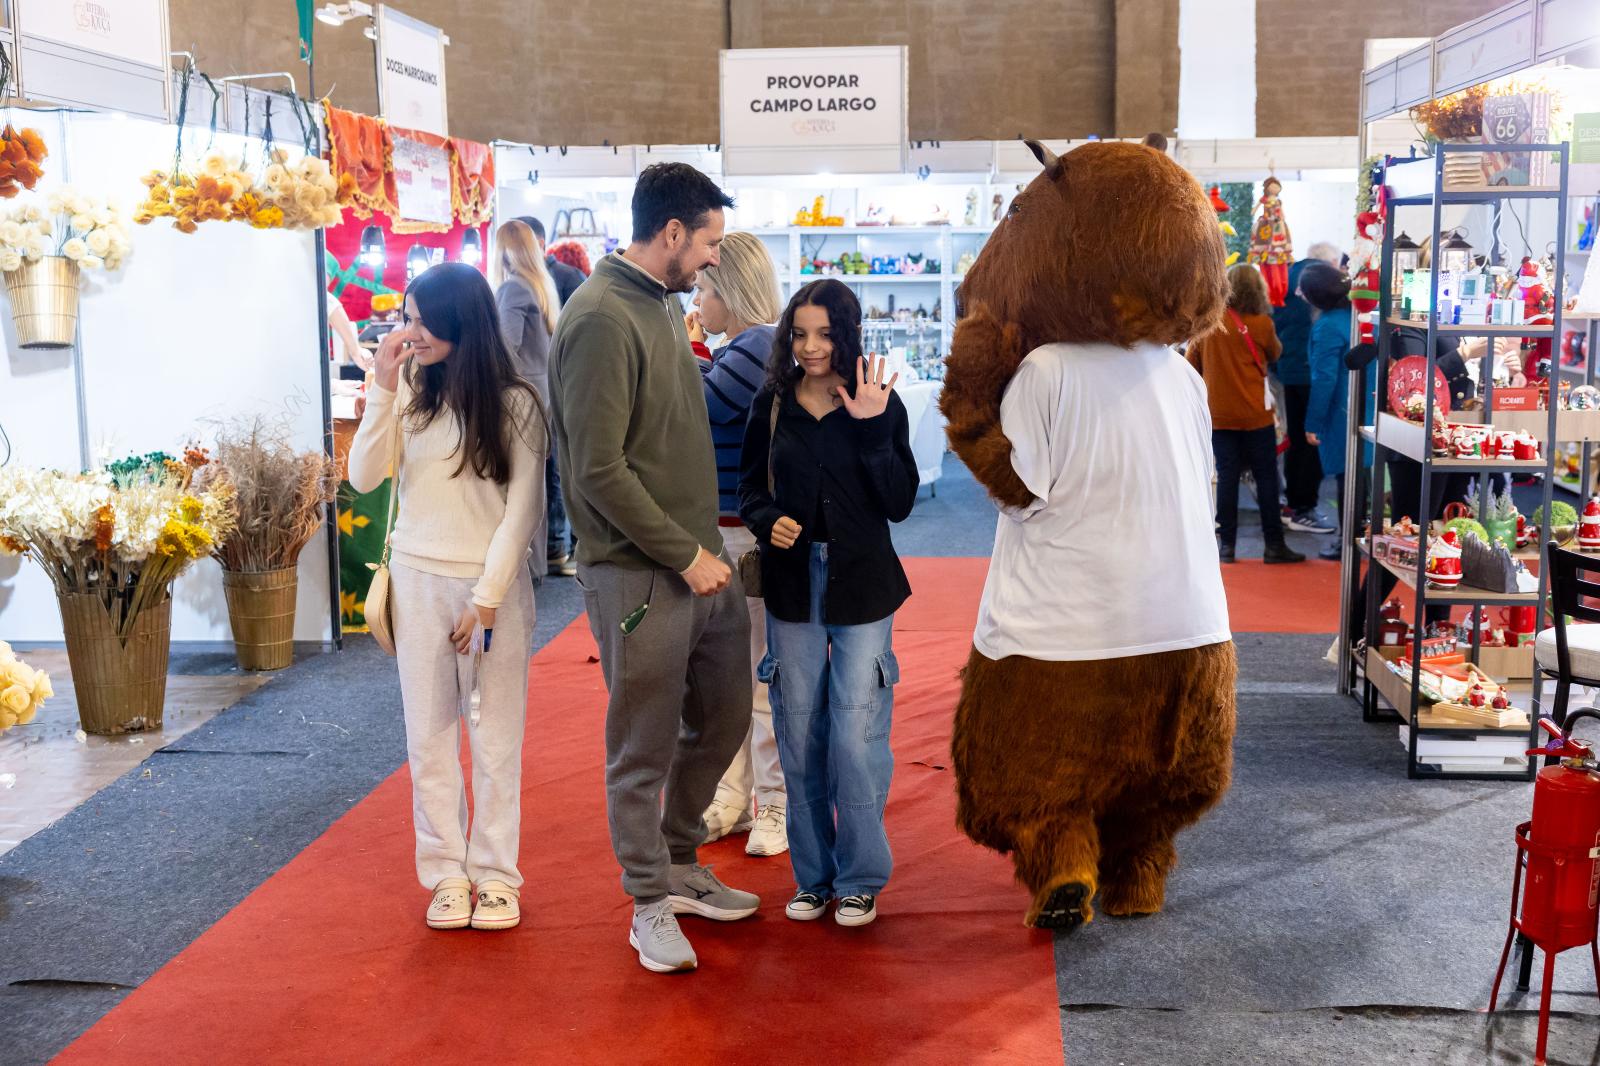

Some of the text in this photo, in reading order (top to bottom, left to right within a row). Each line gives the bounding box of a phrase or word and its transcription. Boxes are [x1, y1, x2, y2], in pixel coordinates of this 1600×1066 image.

[386, 57, 404, 75] DOCES
[767, 75, 859, 89] PROVOPAR
[750, 97, 877, 112] CAMPO LARGO
[1497, 106, 1516, 115] ROUTE
[1496, 117, 1517, 138] 66
